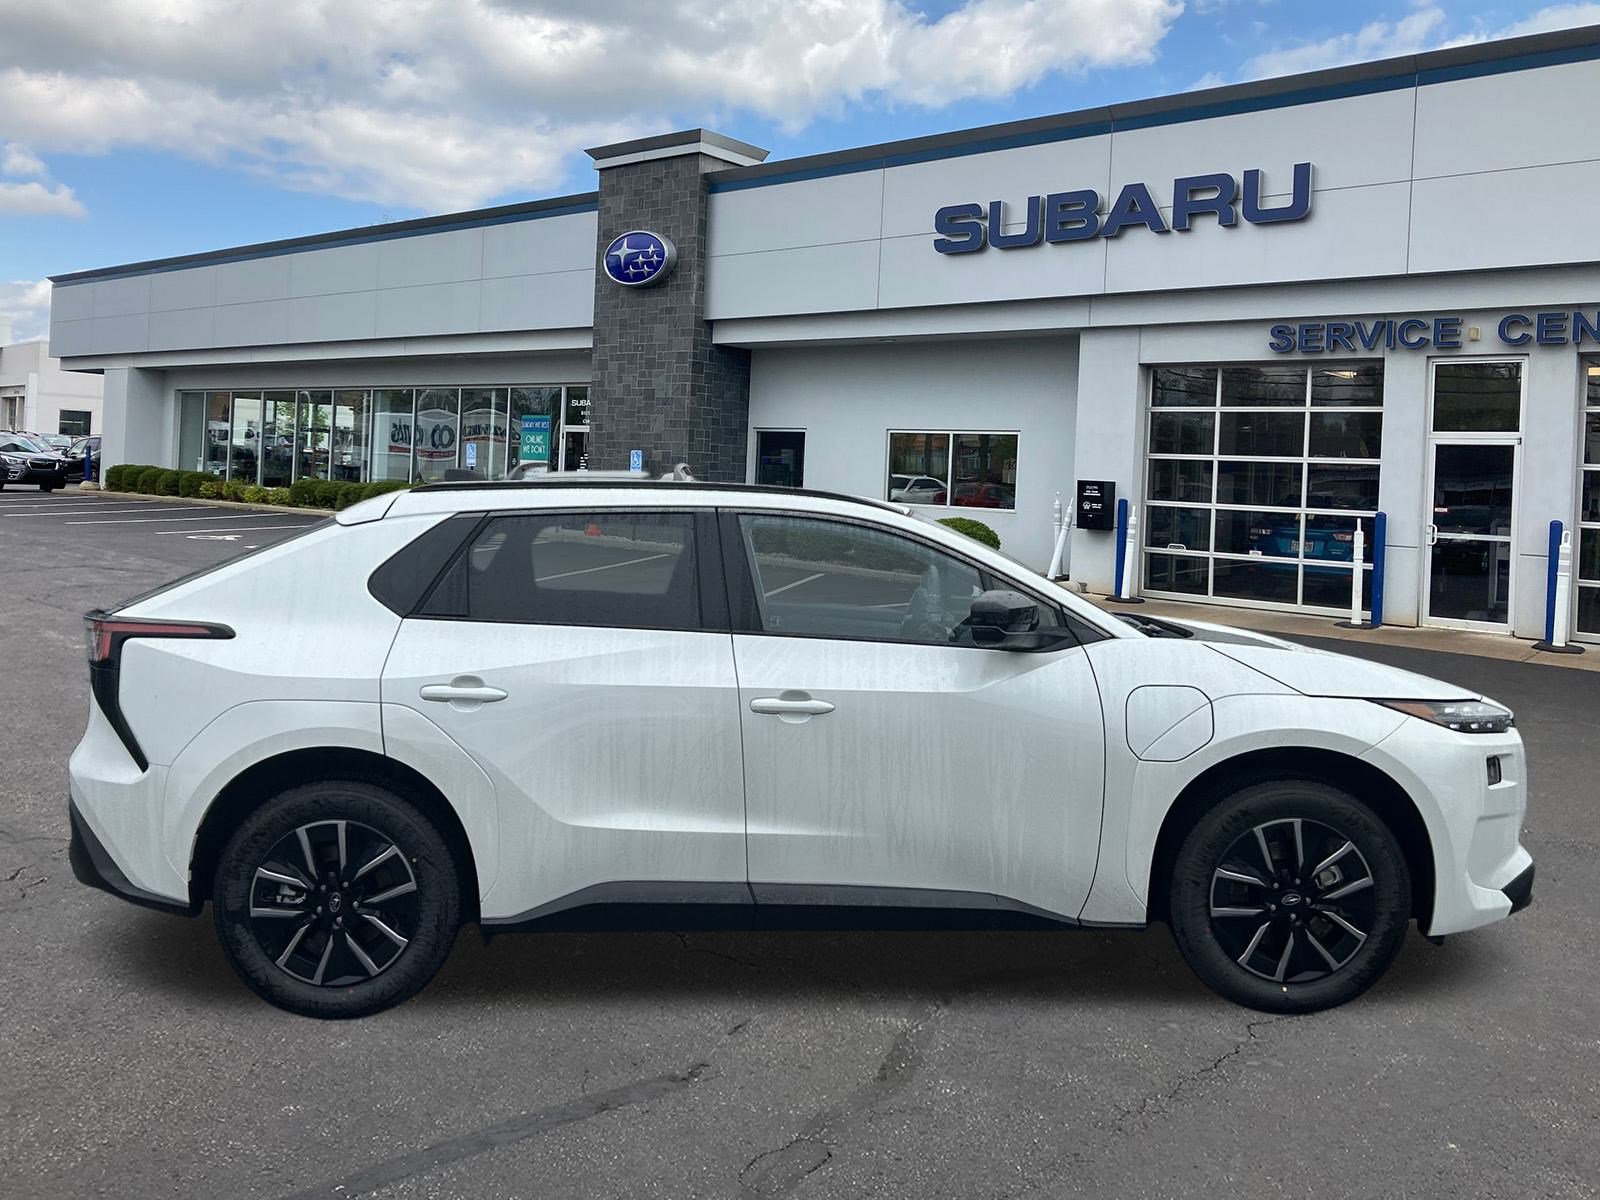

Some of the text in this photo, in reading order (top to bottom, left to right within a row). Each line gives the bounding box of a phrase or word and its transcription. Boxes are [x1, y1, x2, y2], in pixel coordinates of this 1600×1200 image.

[933, 162, 1313, 255] SUBARU
[1268, 311, 1600, 353] SERVICE CEN
[571, 399, 592, 407] SUBA
